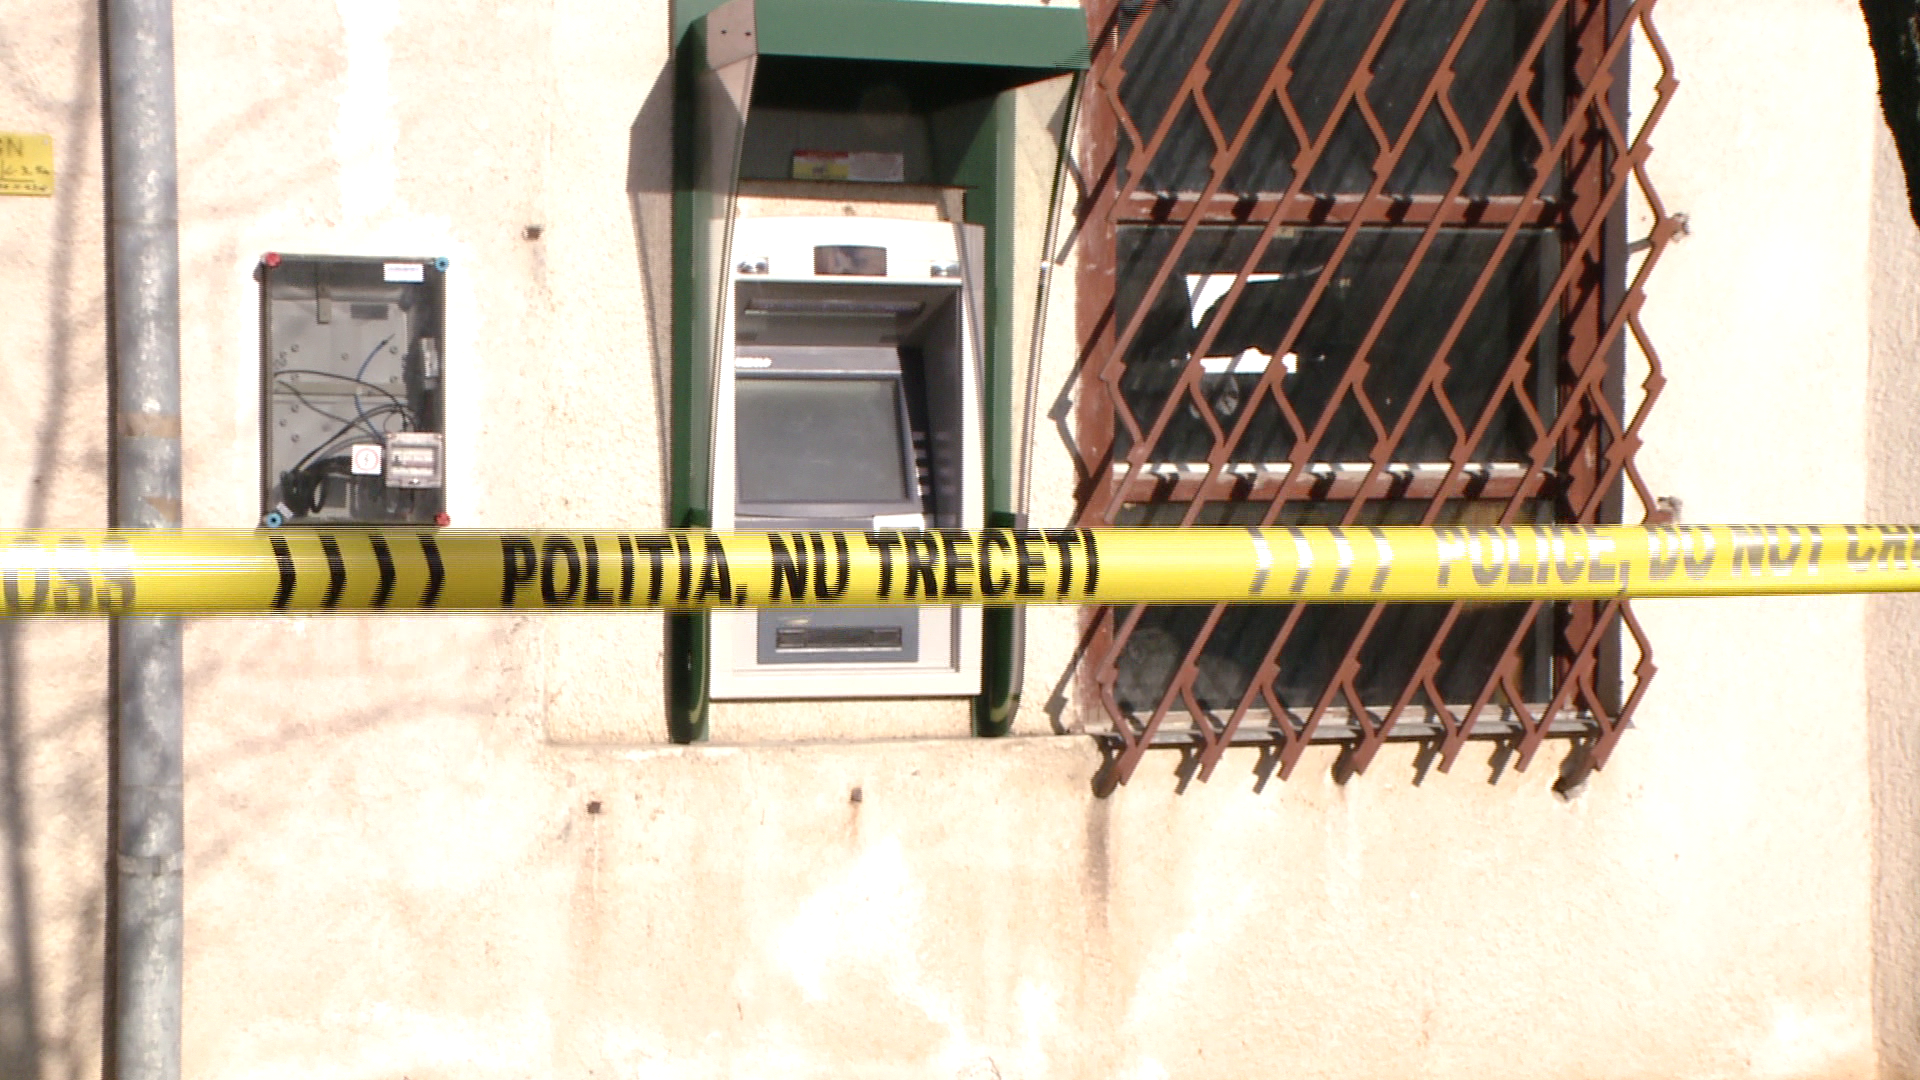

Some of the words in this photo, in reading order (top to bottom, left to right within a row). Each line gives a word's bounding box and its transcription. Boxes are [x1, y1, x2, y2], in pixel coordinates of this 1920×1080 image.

[500, 532, 747, 608] POLITIA,
[767, 531, 851, 601] NU
[863, 528, 1099, 600] TRECETI
[1432, 526, 1631, 594] POLICE,
[1643, 525, 1717, 582] DO
[1728, 525, 1824, 577] NOT
